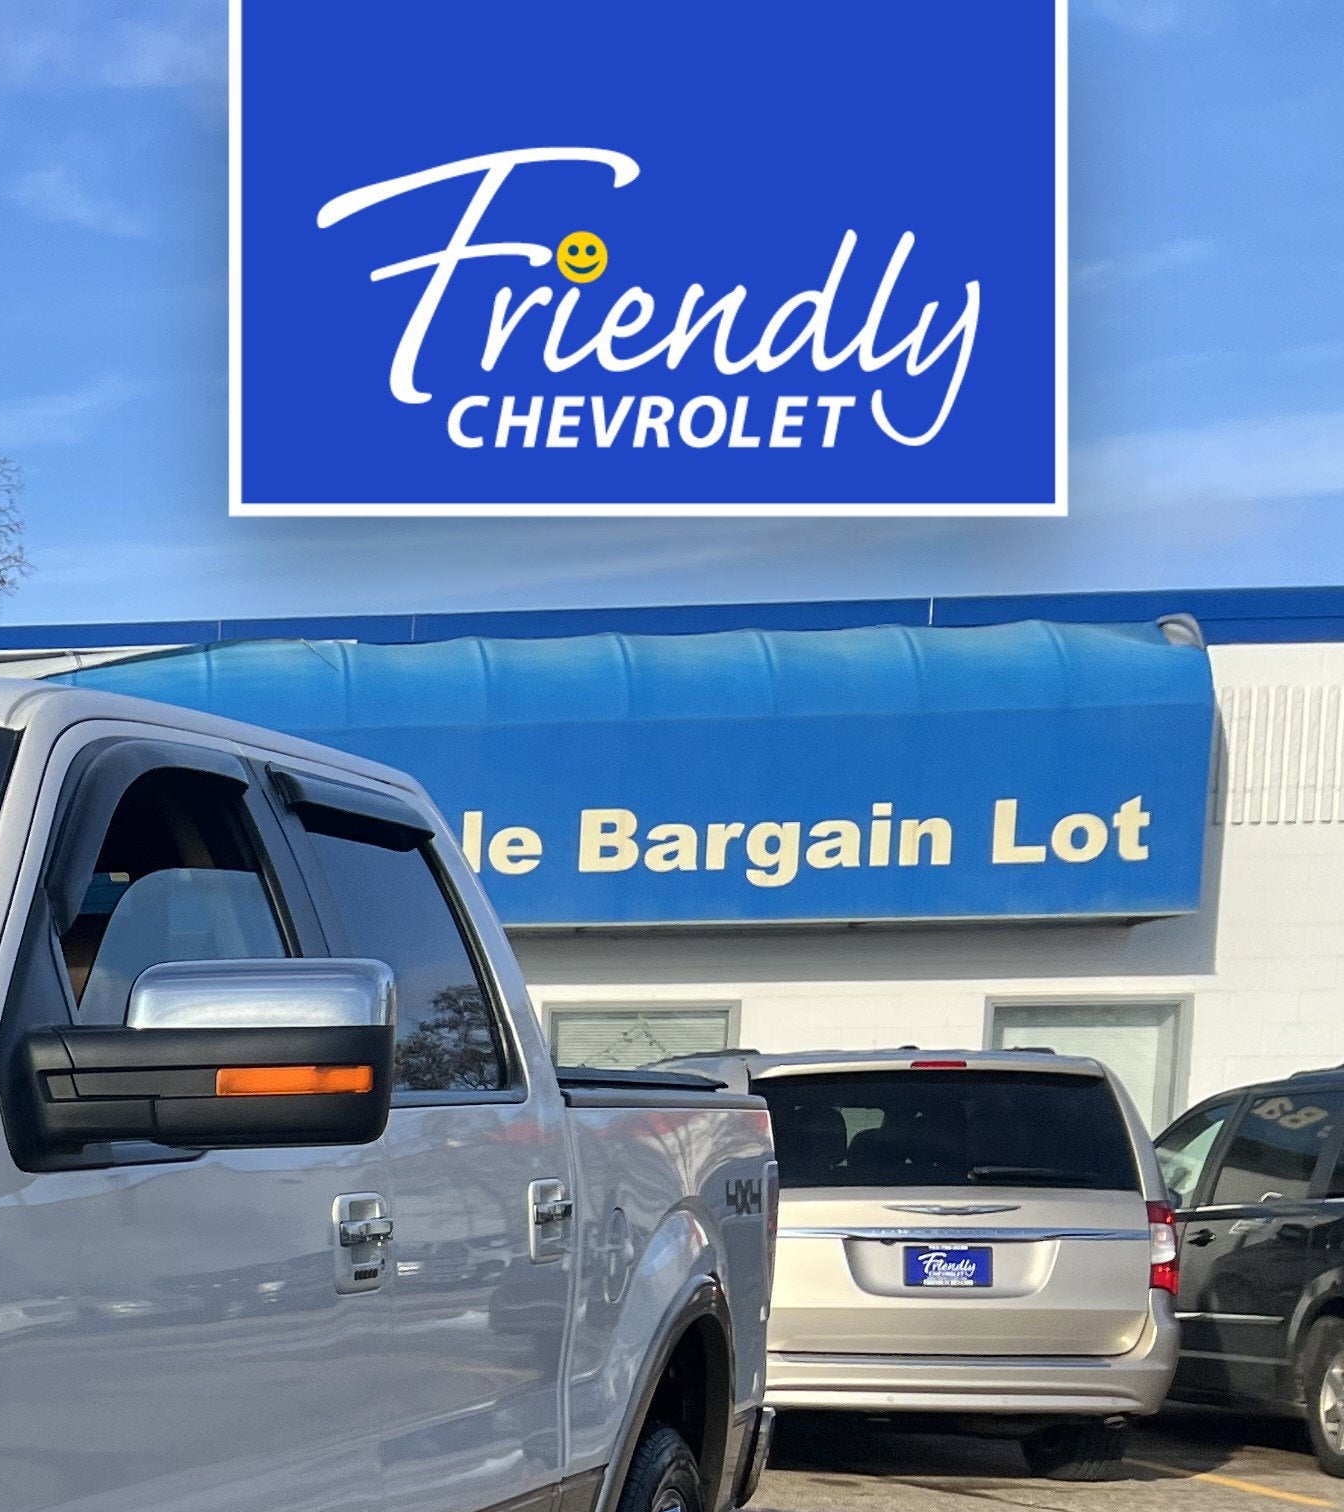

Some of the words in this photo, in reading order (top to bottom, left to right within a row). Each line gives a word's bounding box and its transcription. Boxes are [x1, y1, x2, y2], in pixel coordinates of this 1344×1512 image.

[579, 802, 952, 887] Bargain
[993, 794, 1152, 865] Lot
[917, 1251, 976, 1278] Friendly
